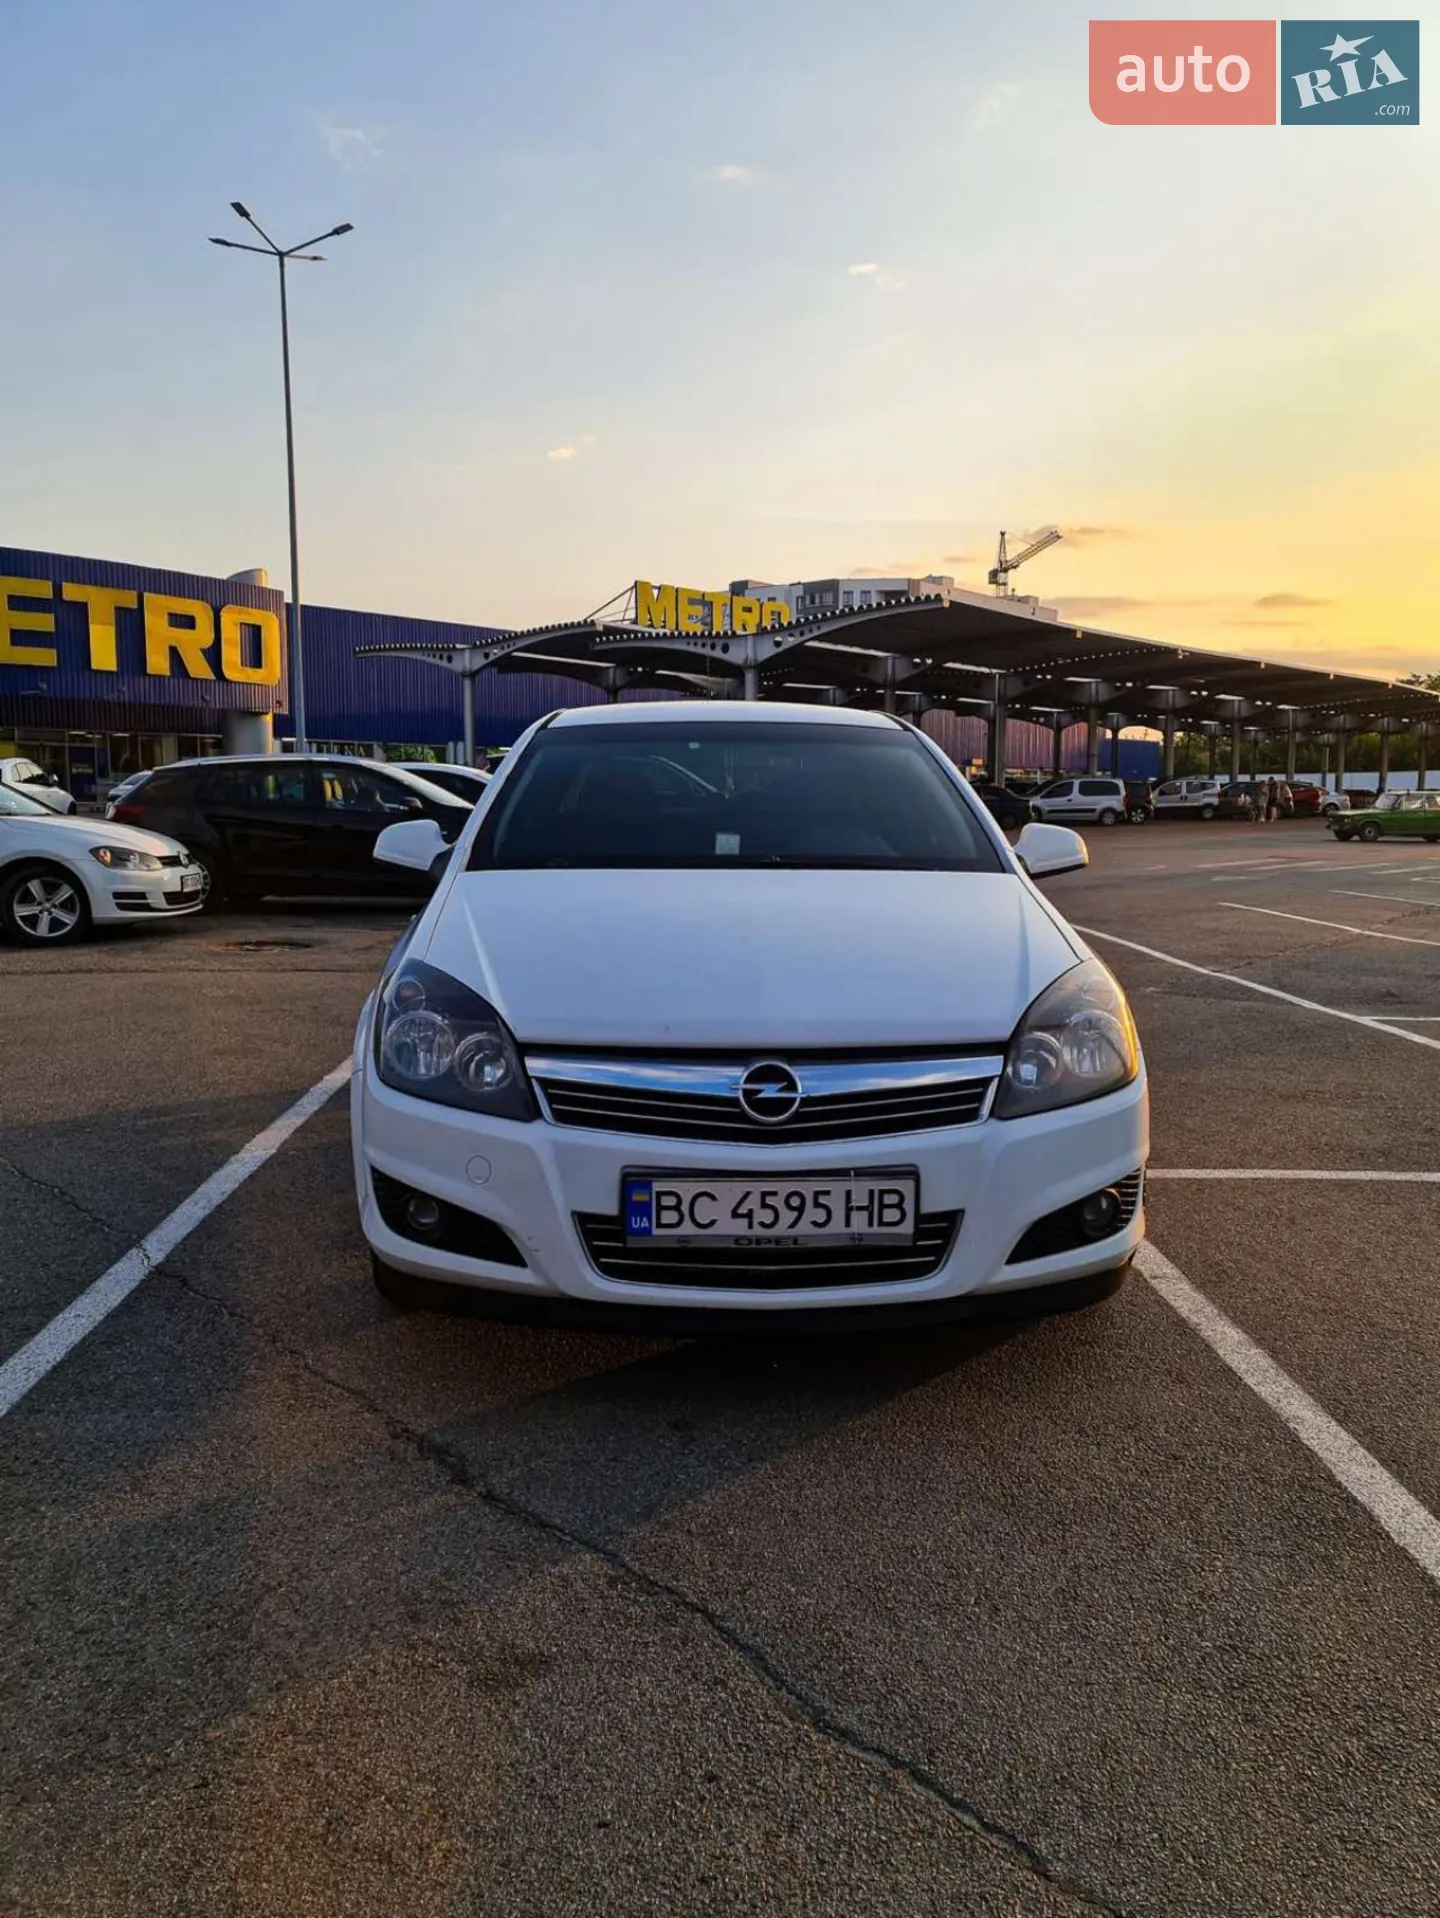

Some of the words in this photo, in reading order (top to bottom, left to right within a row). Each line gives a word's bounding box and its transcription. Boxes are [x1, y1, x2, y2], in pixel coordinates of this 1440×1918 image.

[635, 580, 791, 635] METRO
[0, 576, 281, 686] ETRO
[631, 1216, 650, 1229] UA
[654, 1189, 719, 1229] BC
[730, 1189, 833, 1229] 4595
[844, 1188, 907, 1228] HB
[733, 1237, 807, 1247] OPEL
